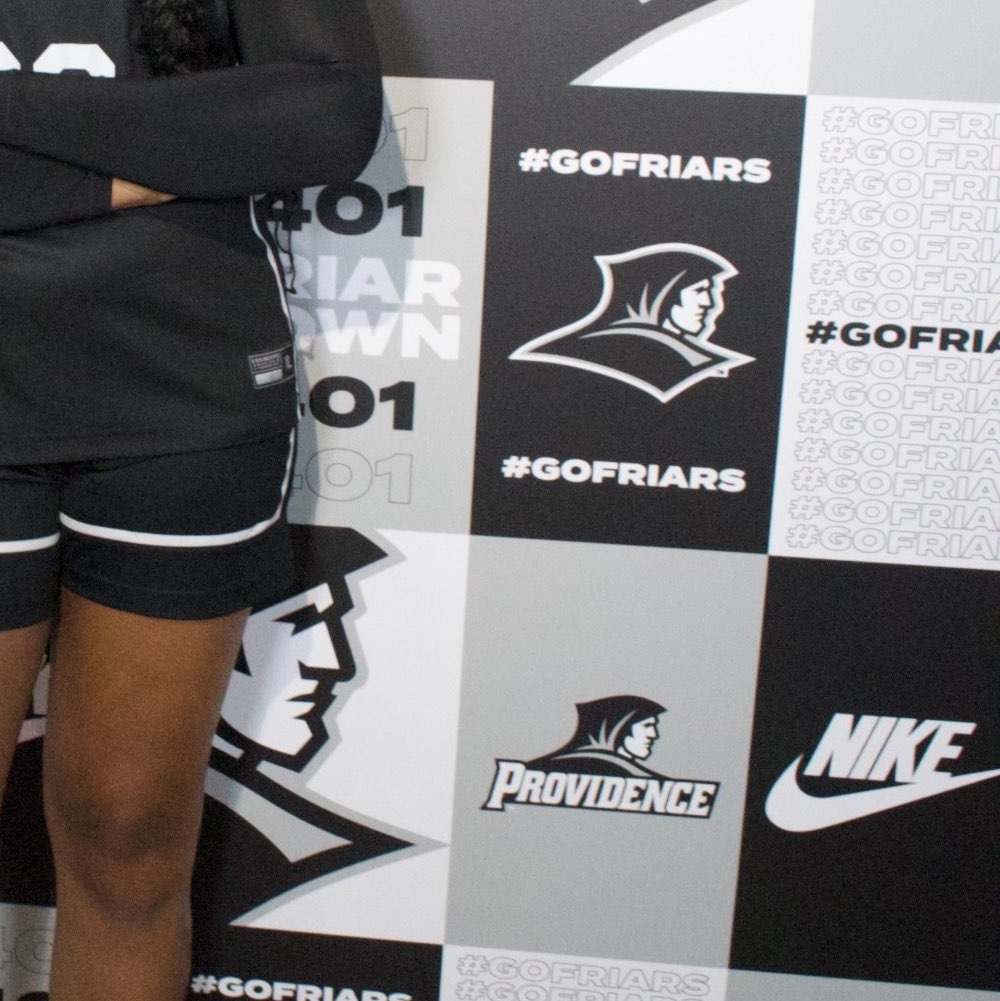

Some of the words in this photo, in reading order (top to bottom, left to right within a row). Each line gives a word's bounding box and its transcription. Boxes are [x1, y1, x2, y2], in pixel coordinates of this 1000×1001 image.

[518, 147, 772, 184] #GOFRIARS
[815, 199, 1000, 232] #GOFRI
[812, 230, 1000, 263] #GOFRI
[300, 374, 416, 432] 01
[294, 447, 414, 505] 01
[502, 455, 747, 493] #GOFRIARS
[786, 524, 1000, 560] #GOFRIA
[804, 712, 977, 784] NIKE
[483, 760, 719, 817] PROVIDENCE
[456, 953, 710, 997] #GOFRIARS
